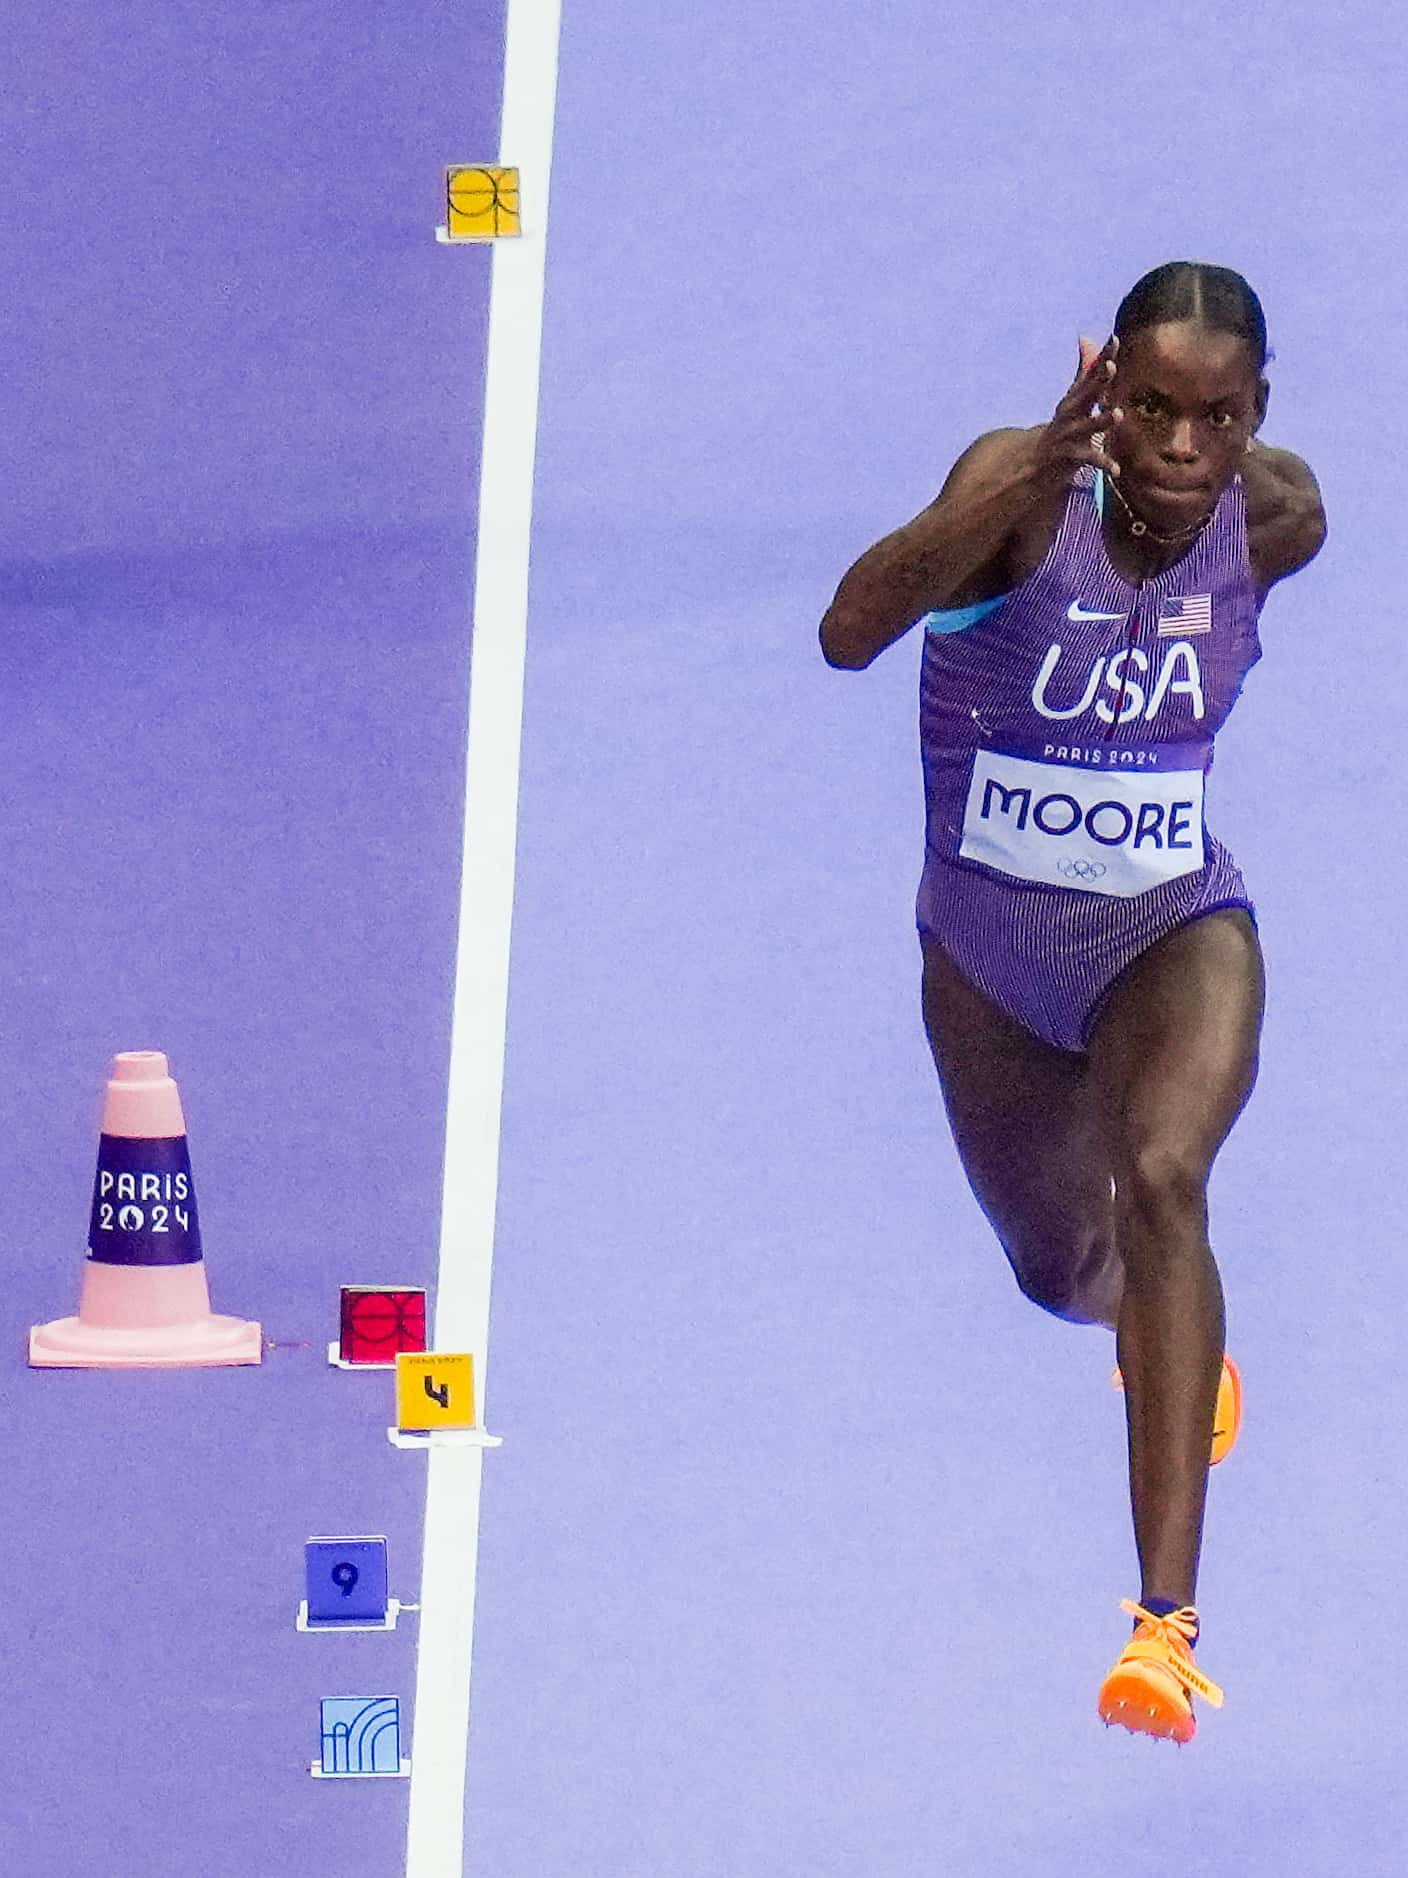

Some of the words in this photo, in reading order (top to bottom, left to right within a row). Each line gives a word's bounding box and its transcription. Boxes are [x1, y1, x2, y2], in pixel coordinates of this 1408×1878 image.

[1031, 641, 1205, 724] USA
[1044, 743, 1102, 763] PARIS
[980, 778, 1194, 850] MOORE
[100, 1170, 188, 1200] PARIS
[100, 1203, 188, 1232] 2024
[424, 1375, 449, 1408] 4
[331, 1562, 359, 1597] 9
